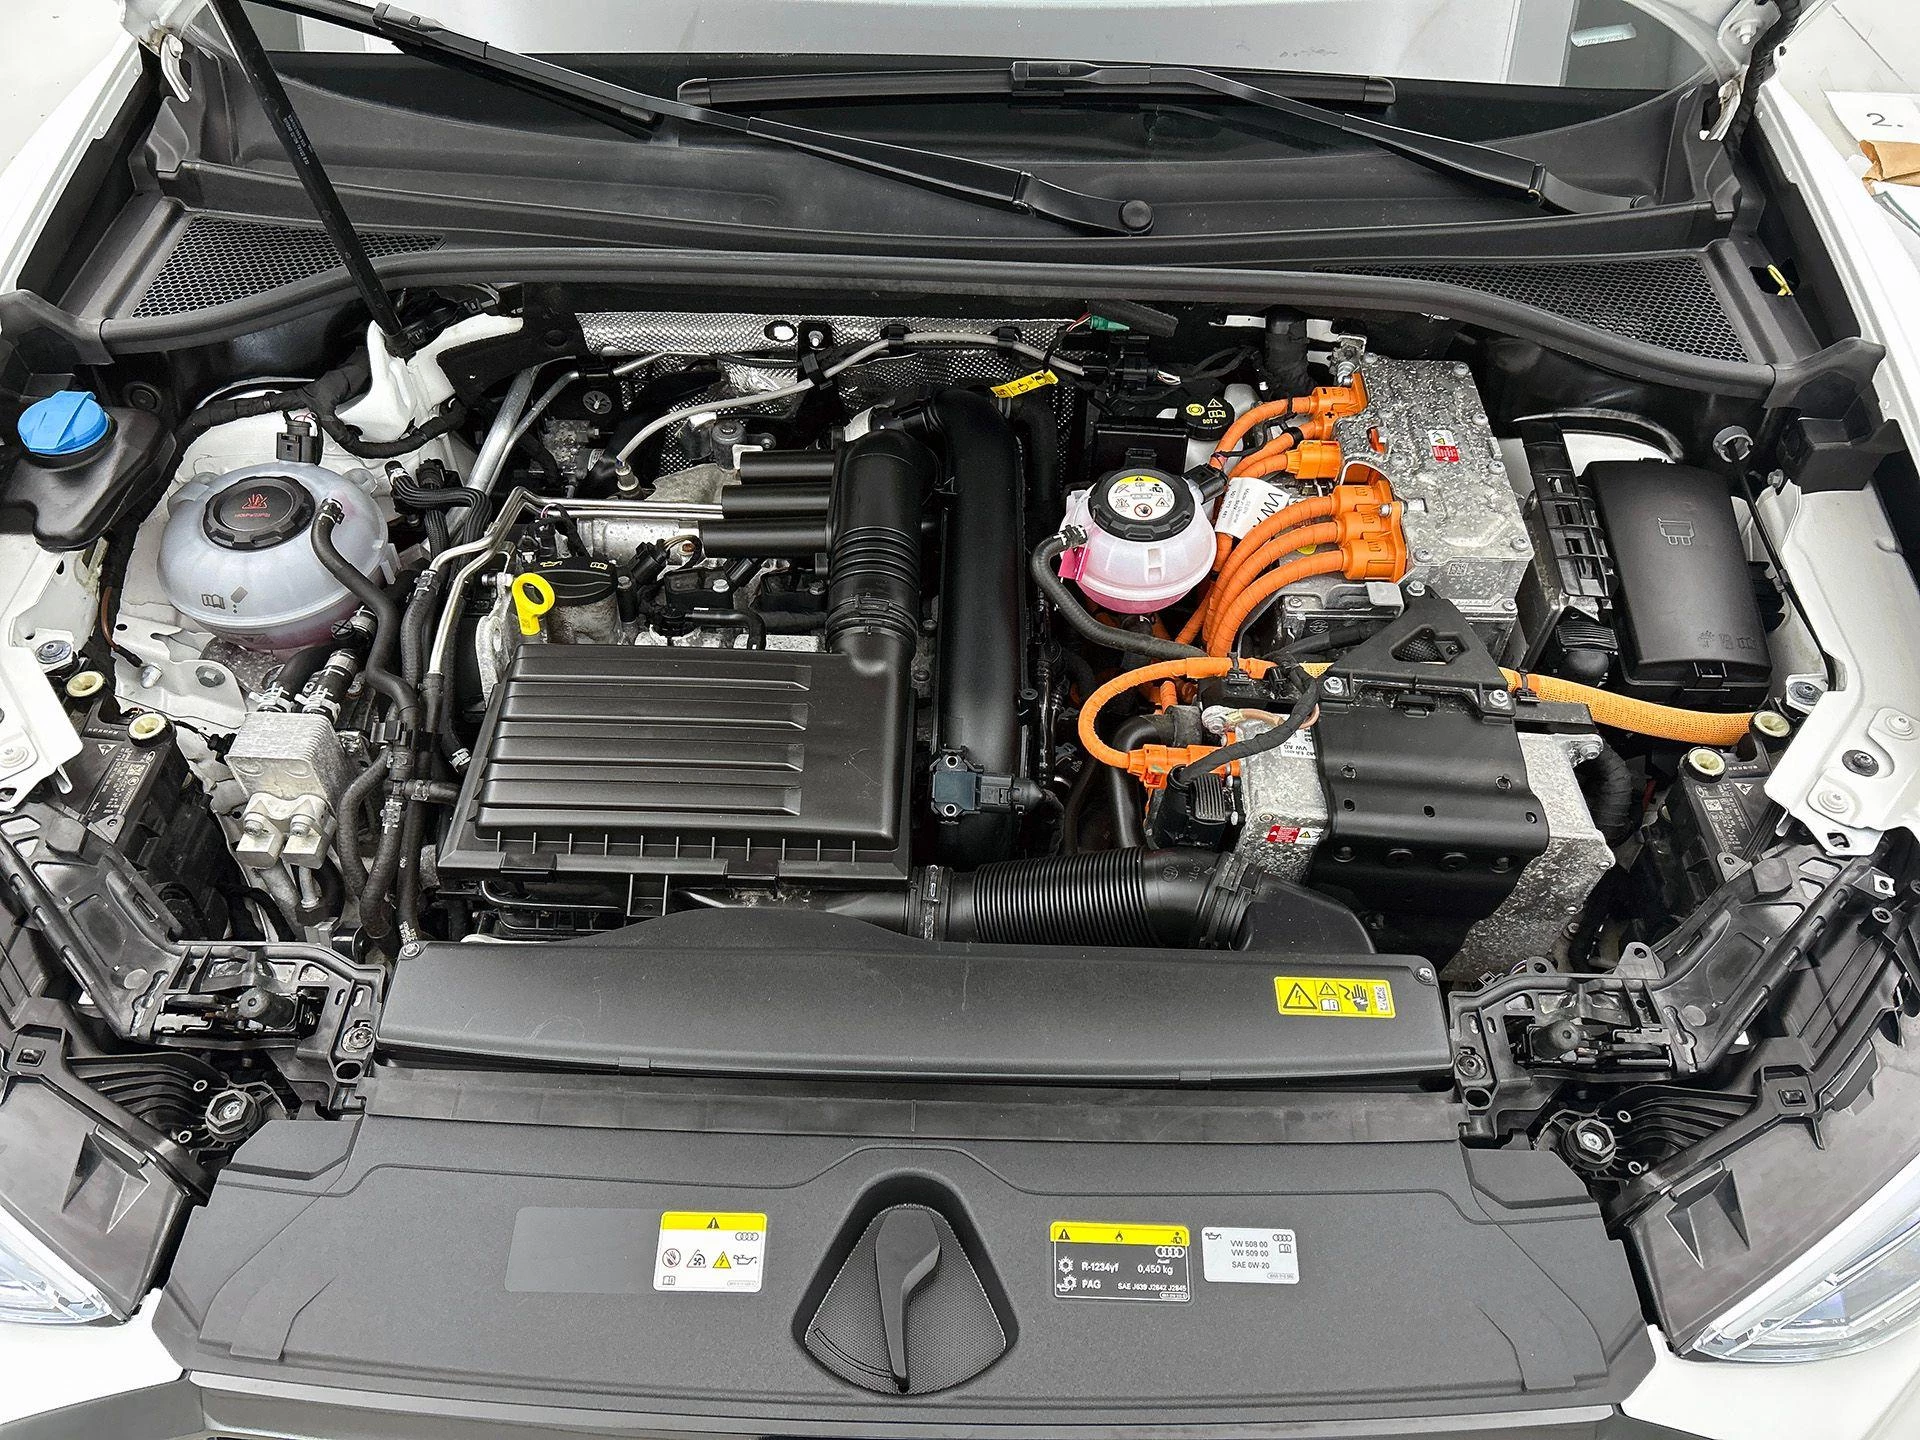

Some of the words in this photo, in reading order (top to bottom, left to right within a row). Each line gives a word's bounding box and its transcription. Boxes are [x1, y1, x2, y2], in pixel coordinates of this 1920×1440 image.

[1866, 112, 1904, 128] 2.
[1245, 1240, 1258, 1248] 508
[1081, 1261, 1119, 1273] R-1234yf
[1231, 1260, 1246, 1268] SAE
[1248, 1261, 1270, 1269] 0W-20
[1137, 1264, 1161, 1274] 0,450
[1162, 1265, 1174, 1276] kg
[1081, 1279, 1101, 1289] PAG
[1117, 1282, 1131, 1290] SAE
